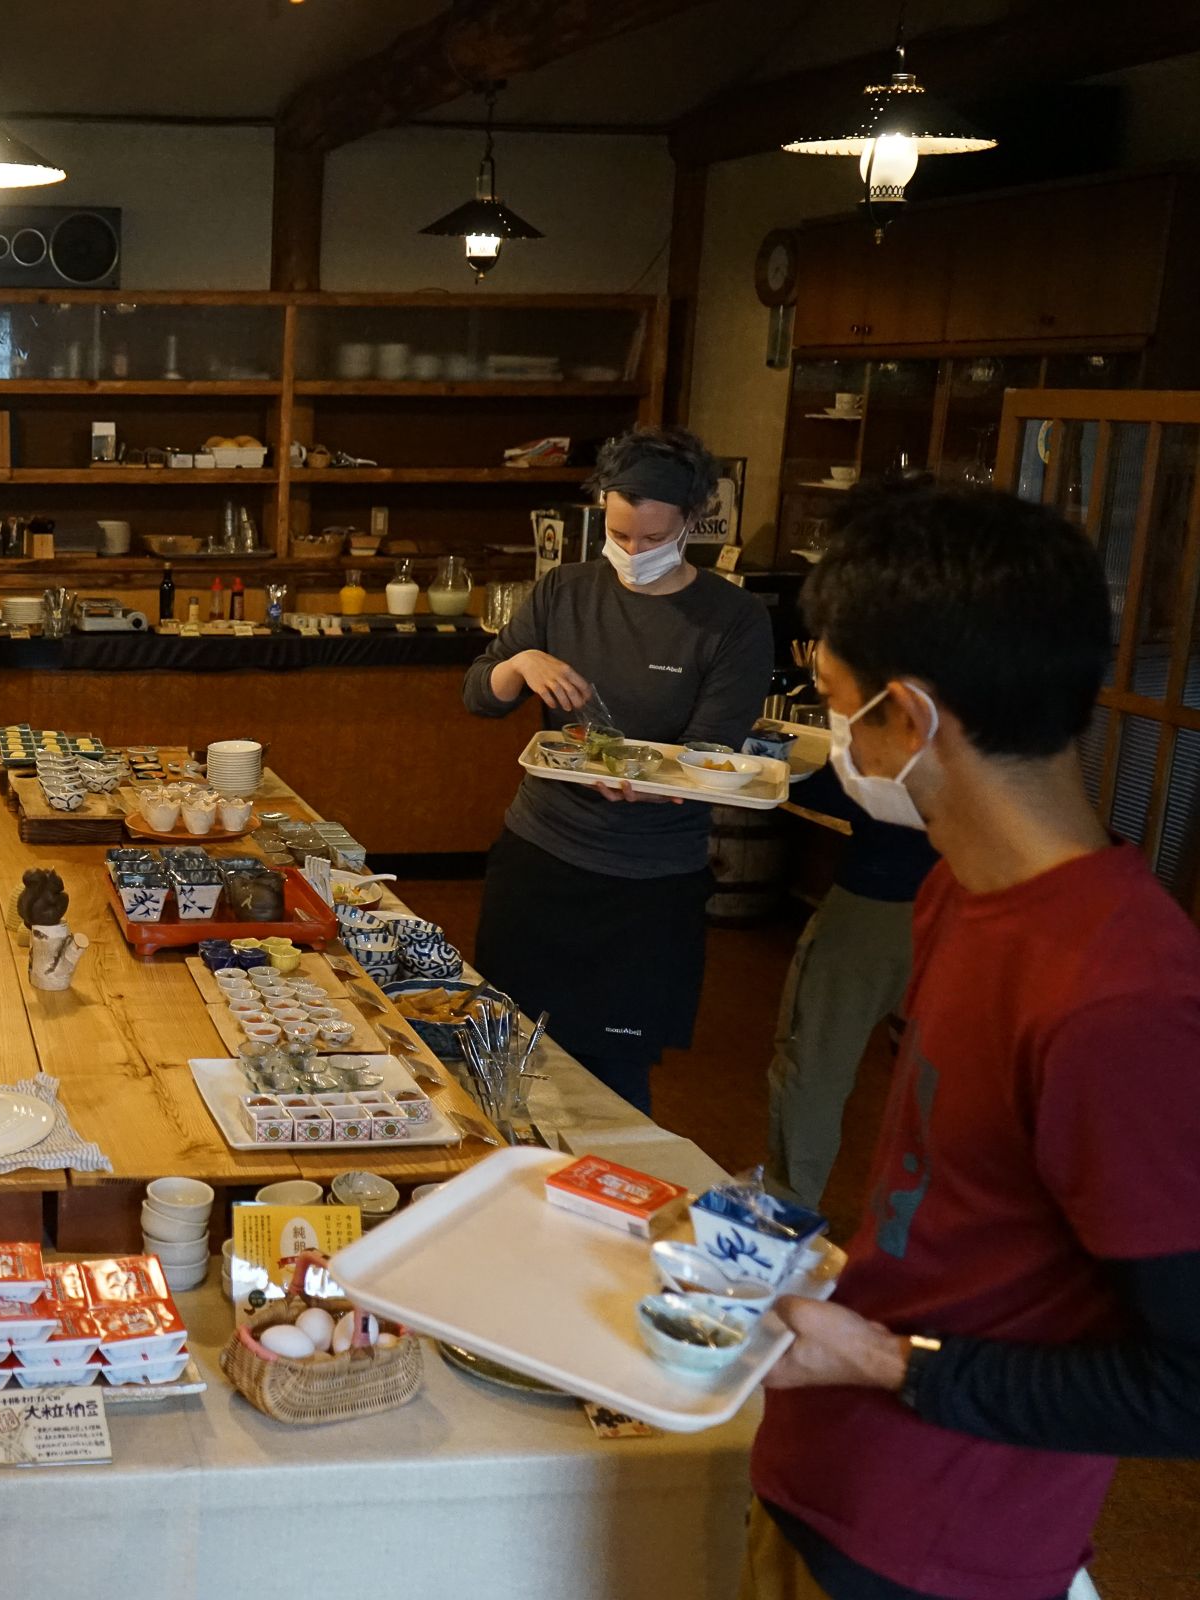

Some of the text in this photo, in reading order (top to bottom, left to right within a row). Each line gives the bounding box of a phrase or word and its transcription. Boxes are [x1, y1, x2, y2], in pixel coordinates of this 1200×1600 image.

[688, 518, 728, 535] ASSIC
[24, 1400, 99, 1421] 大粒納豆
